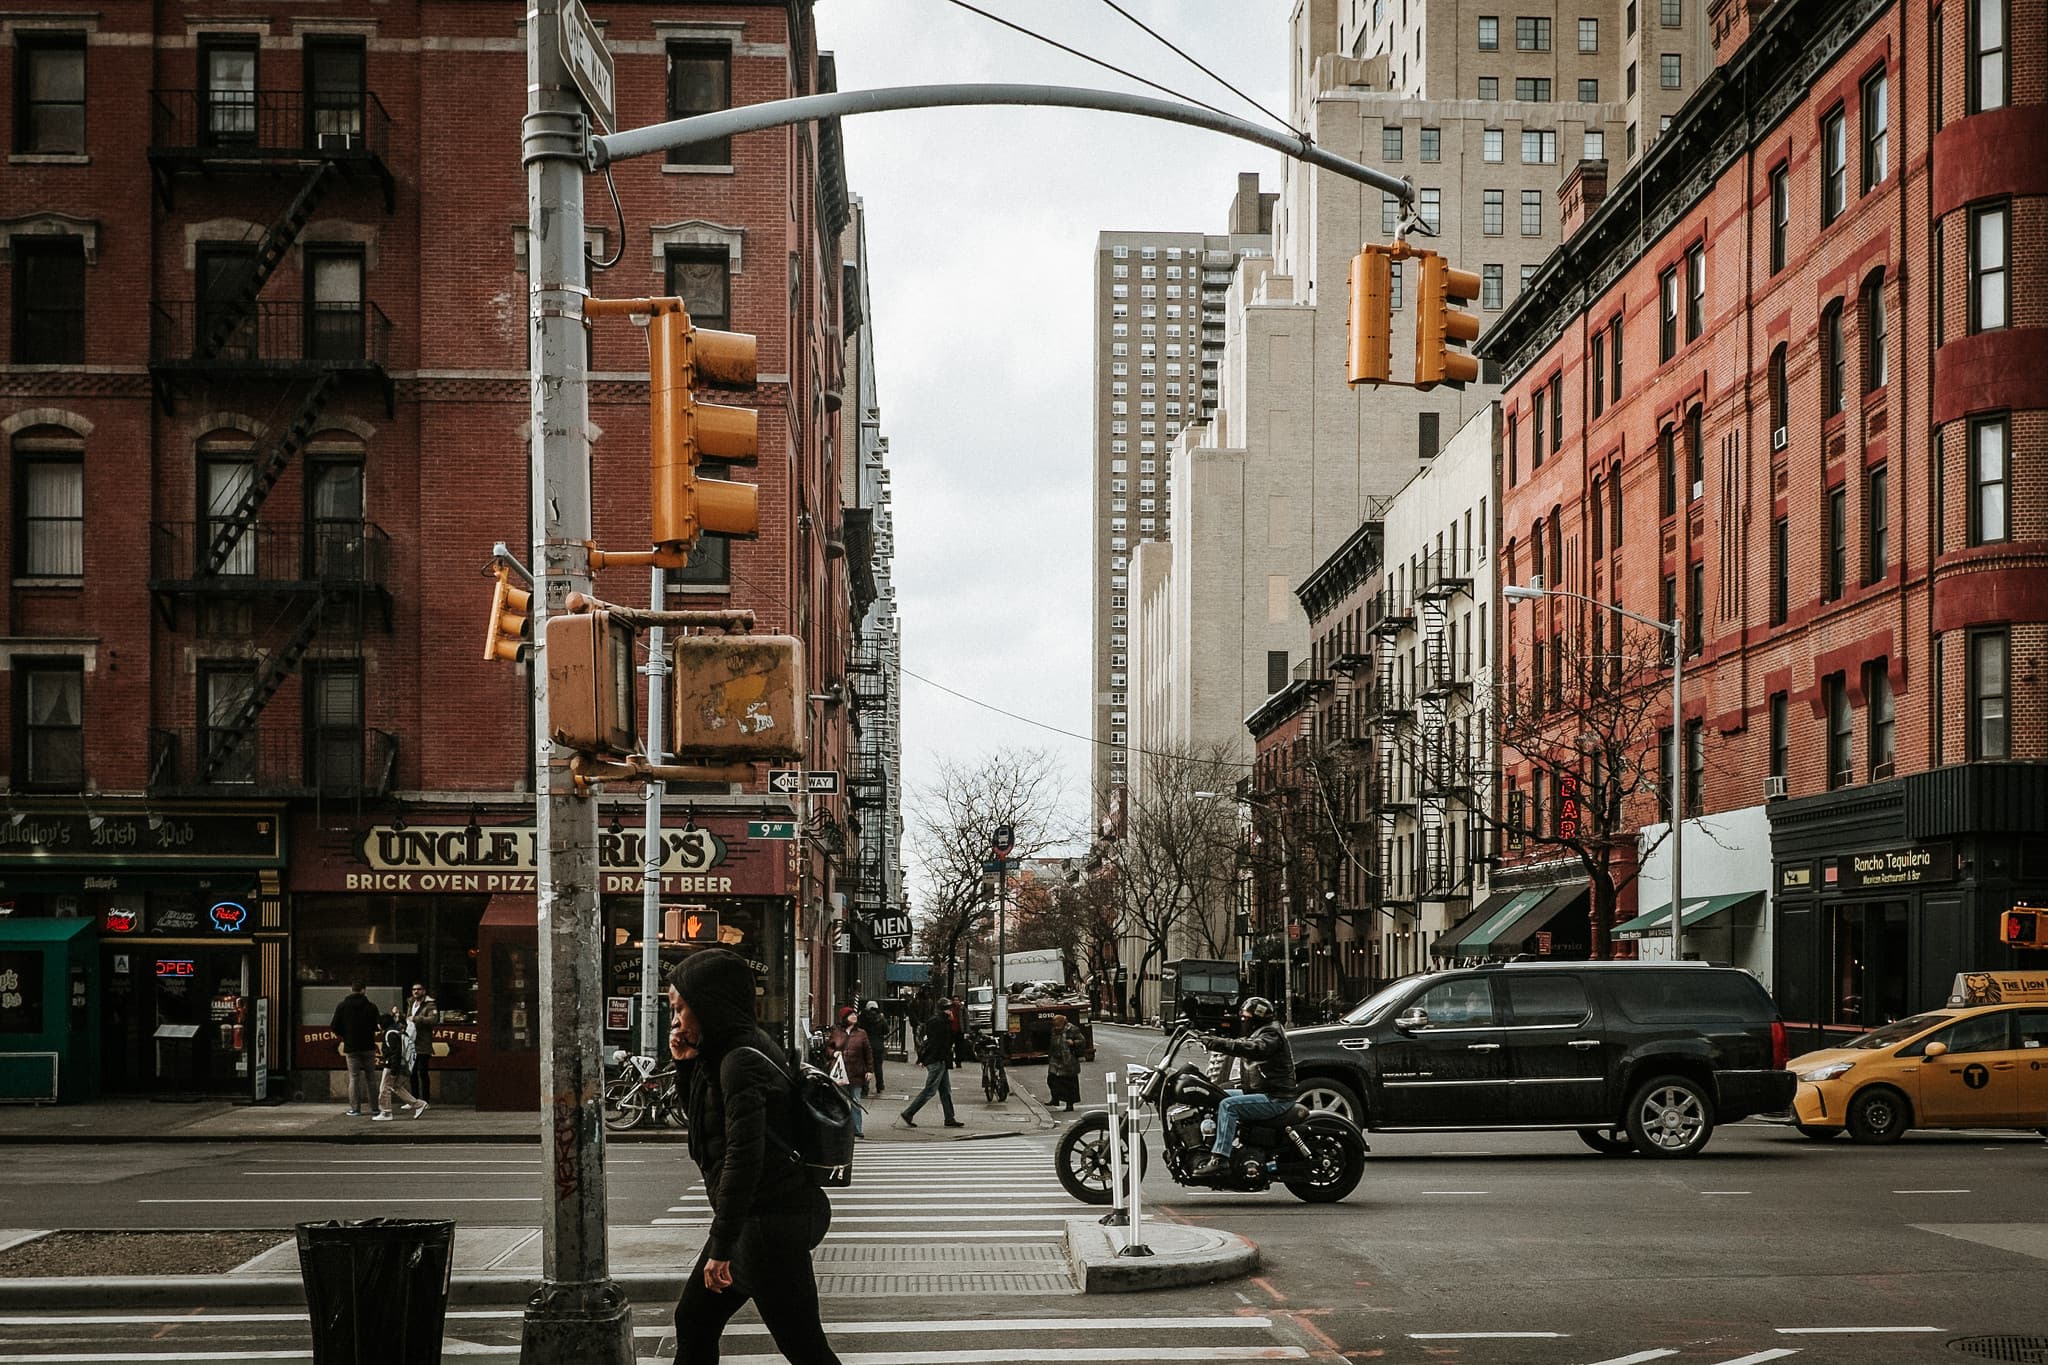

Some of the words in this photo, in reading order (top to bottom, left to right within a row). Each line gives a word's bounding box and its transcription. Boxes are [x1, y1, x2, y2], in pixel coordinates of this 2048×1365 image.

[568, 12, 584, 66] ONE
[591, 50, 607, 102] WAY
[780, 777, 798, 787] ONE
[808, 777, 829, 787] WAY
[1560, 776, 1578, 839] BAR
[91, 822, 137, 846] Irish
[157, 821, 194, 848] Pub
[761, 824, 770, 837] 9
[376, 831, 519, 867] UNCLE
[1854, 854, 1884, 872] Rancho
[1885, 849, 1931, 872] Tequileria
[346, 874, 412, 890] BRICK
[420, 874, 479, 891] OVEN
[487, 875, 536, 891] PIZZ
[681, 876, 732, 893] BEER
[874, 916, 908, 936] MEN
[882, 937, 903, 949] SPA
[118, 957, 126, 968] A
[156, 962, 194, 974] OPEN
[2002, 981, 2019, 991] THE
[2020, 979, 2044, 991] LION
[304, 1031, 338, 1043] BRICK
[458, 1032, 478, 1042] BEE
